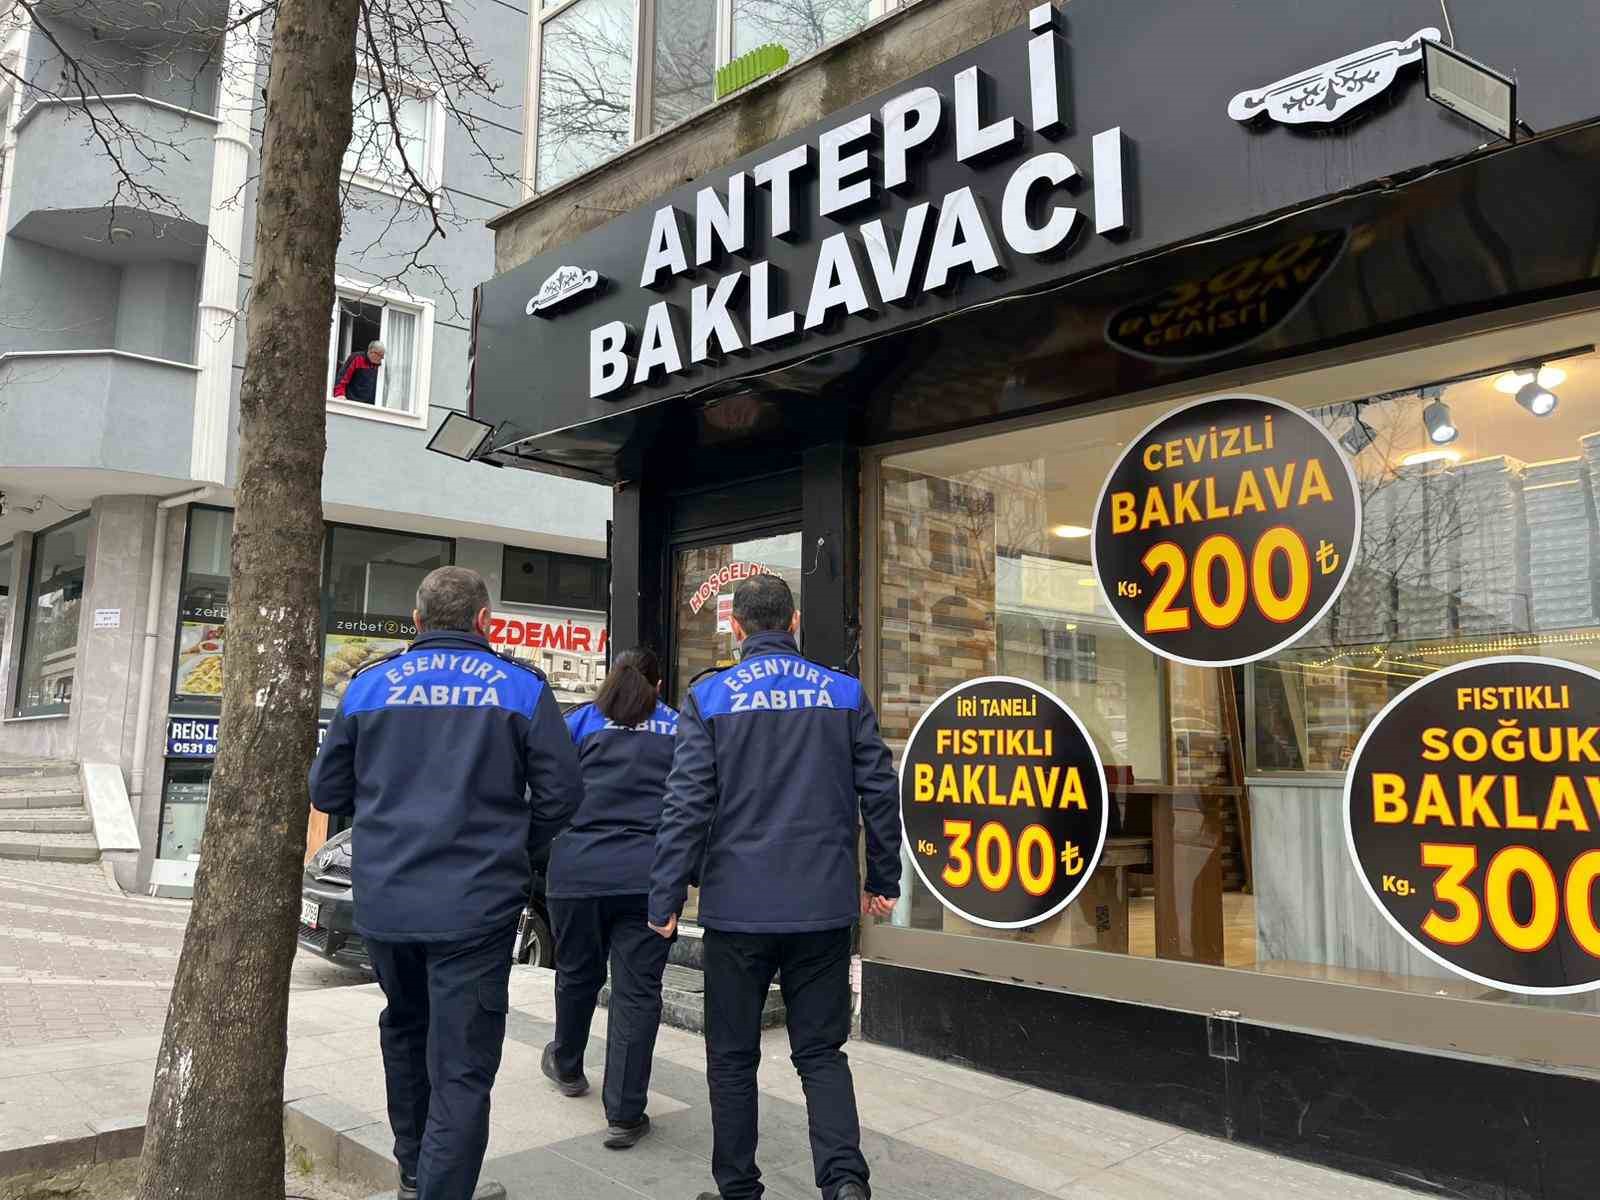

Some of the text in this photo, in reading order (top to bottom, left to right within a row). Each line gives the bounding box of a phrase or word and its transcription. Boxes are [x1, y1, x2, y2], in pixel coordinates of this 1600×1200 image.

[640, 2, 1060, 288] ANTEPLİ
[590, 126, 1125, 399] BAKLAVACI
[1143, 415, 1275, 471] CEVİZLİ
[1111, 458, 1334, 535] BAKLAVA
[1117, 580, 1142, 598] Kg.
[1140, 525, 1312, 634] 200
[489, 618, 591, 652] ZDEMİR
[385, 653, 508, 685] ESENYURT
[723, 658, 834, 692] ESENYURT
[385, 684, 500, 705] ZABITA
[730, 689, 834, 713] ZABITA
[957, 694, 1037, 717] İRİ TANELİ
[1456, 685, 1569, 711] FISTIKLI
[172, 721, 219, 740] REİSLE
[603, 718, 678, 735] ZBITA
[936, 729, 1053, 757] FISTIKLI
[1421, 718, 1600, 762] SOĞUK
[173, 742, 203, 753] 0531
[914, 763, 1088, 810] BAKLAVA
[1371, 773, 1600, 832] BAKLA
[918, 839, 937, 860] Kg.
[942, 819, 1056, 897] 300
[1382, 875, 1416, 896] Kg.
